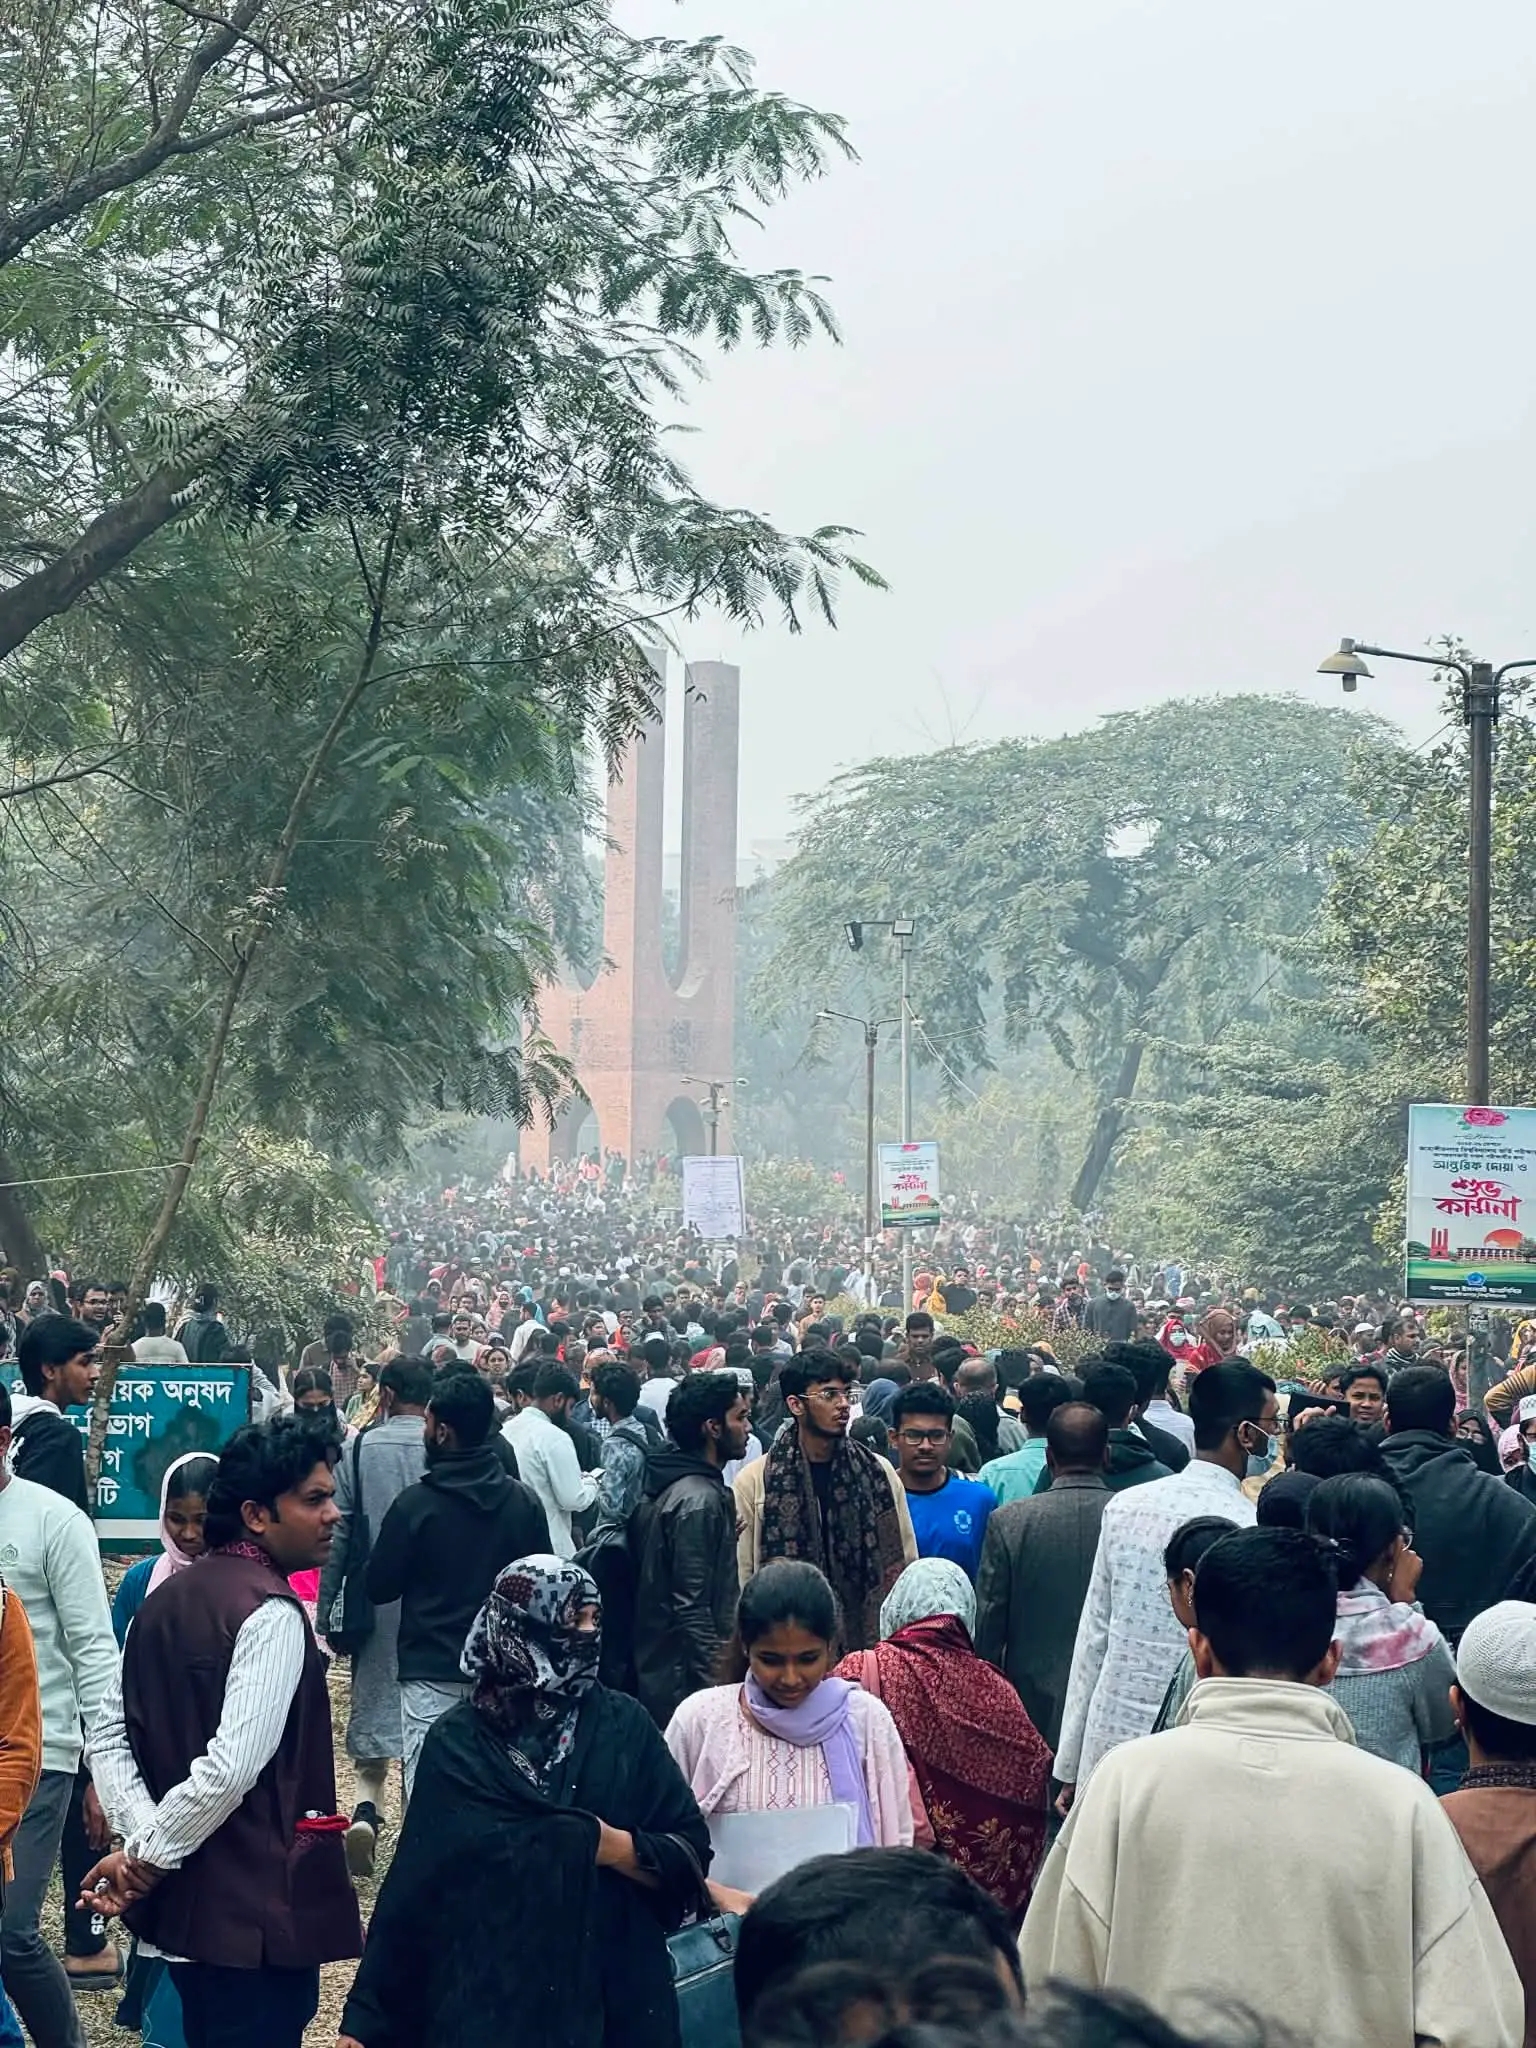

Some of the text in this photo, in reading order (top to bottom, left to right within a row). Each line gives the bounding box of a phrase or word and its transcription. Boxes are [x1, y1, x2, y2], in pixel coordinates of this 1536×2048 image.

[1432, 1159, 1482, 1173] আন্তরিক
[1518, 1163, 1528, 1172] ও
[1451, 1176, 1512, 1198] শুভ
[1432, 1196, 1522, 1222] কামনা
[160, 1380, 236, 1409] অনুষদ
